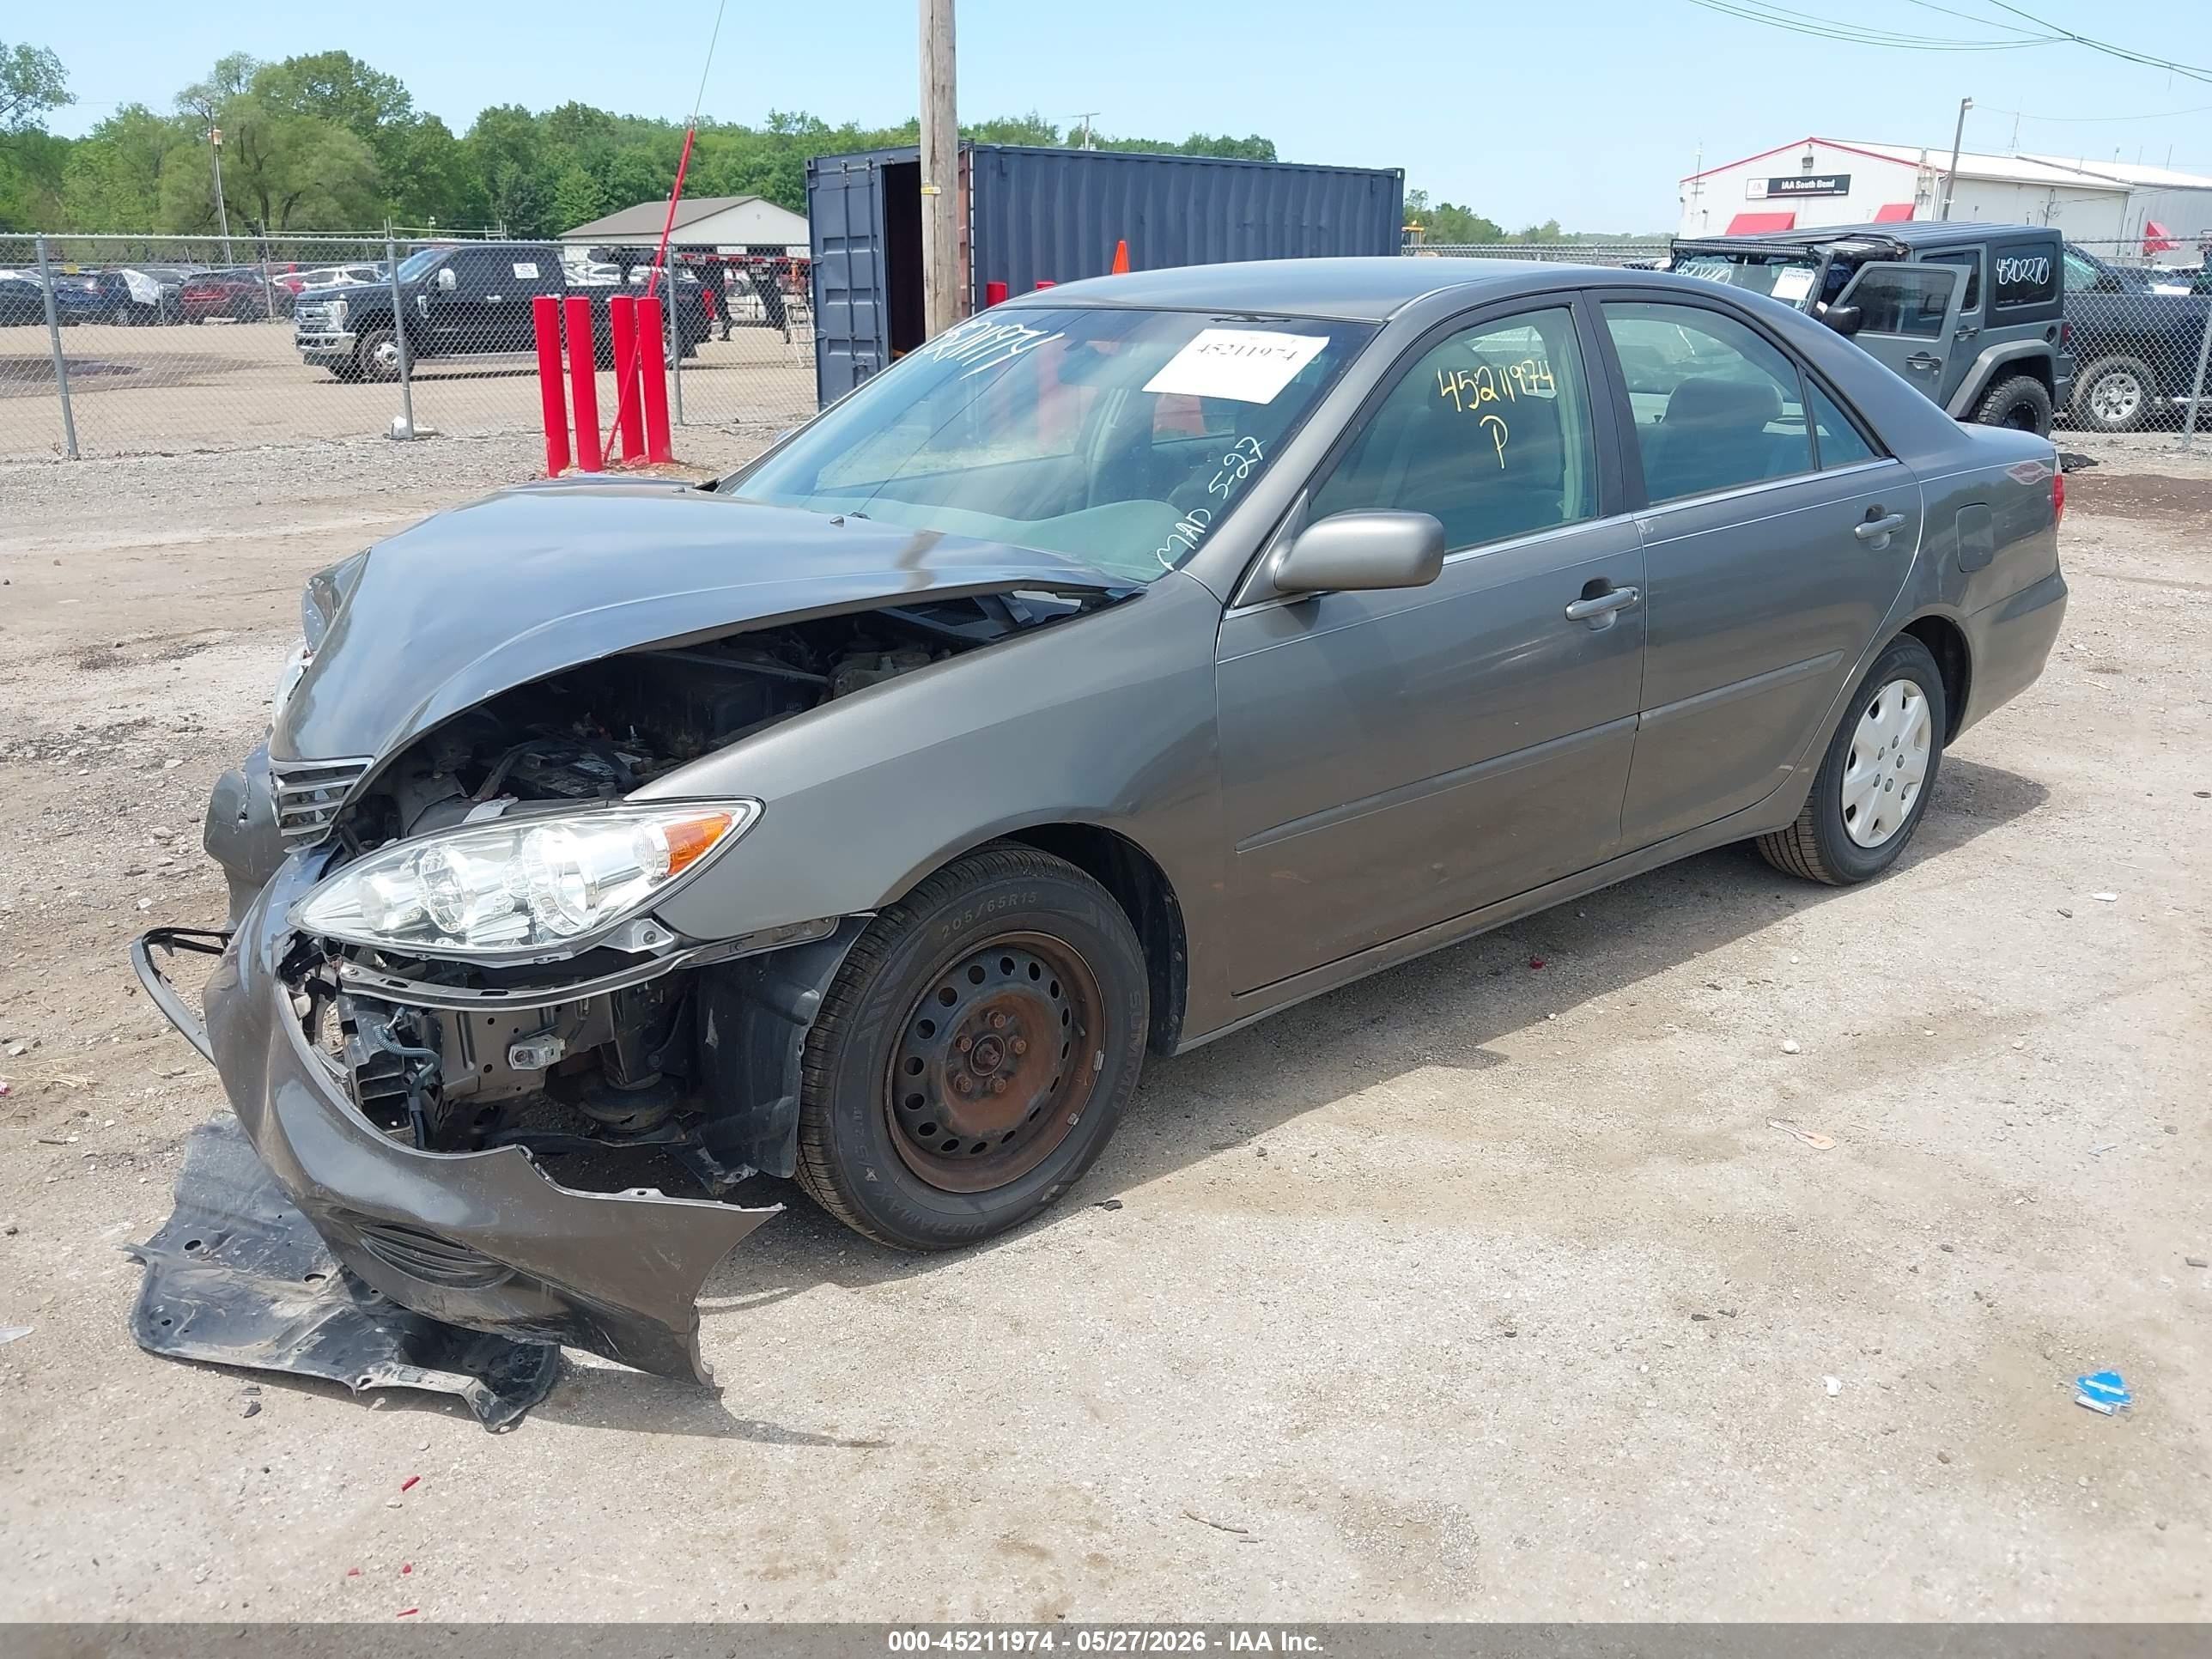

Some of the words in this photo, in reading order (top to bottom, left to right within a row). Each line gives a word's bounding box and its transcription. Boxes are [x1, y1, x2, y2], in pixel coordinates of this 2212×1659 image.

[1781, 180, 1795, 190] IAA
[1796, 179, 1816, 189] South
[1437, 359, 1555, 412] 45211974
[1208, 436, 1267, 500] 5-27
[1480, 415, 1509, 470] P
[941, 892, 1038, 940] 205/65R15
